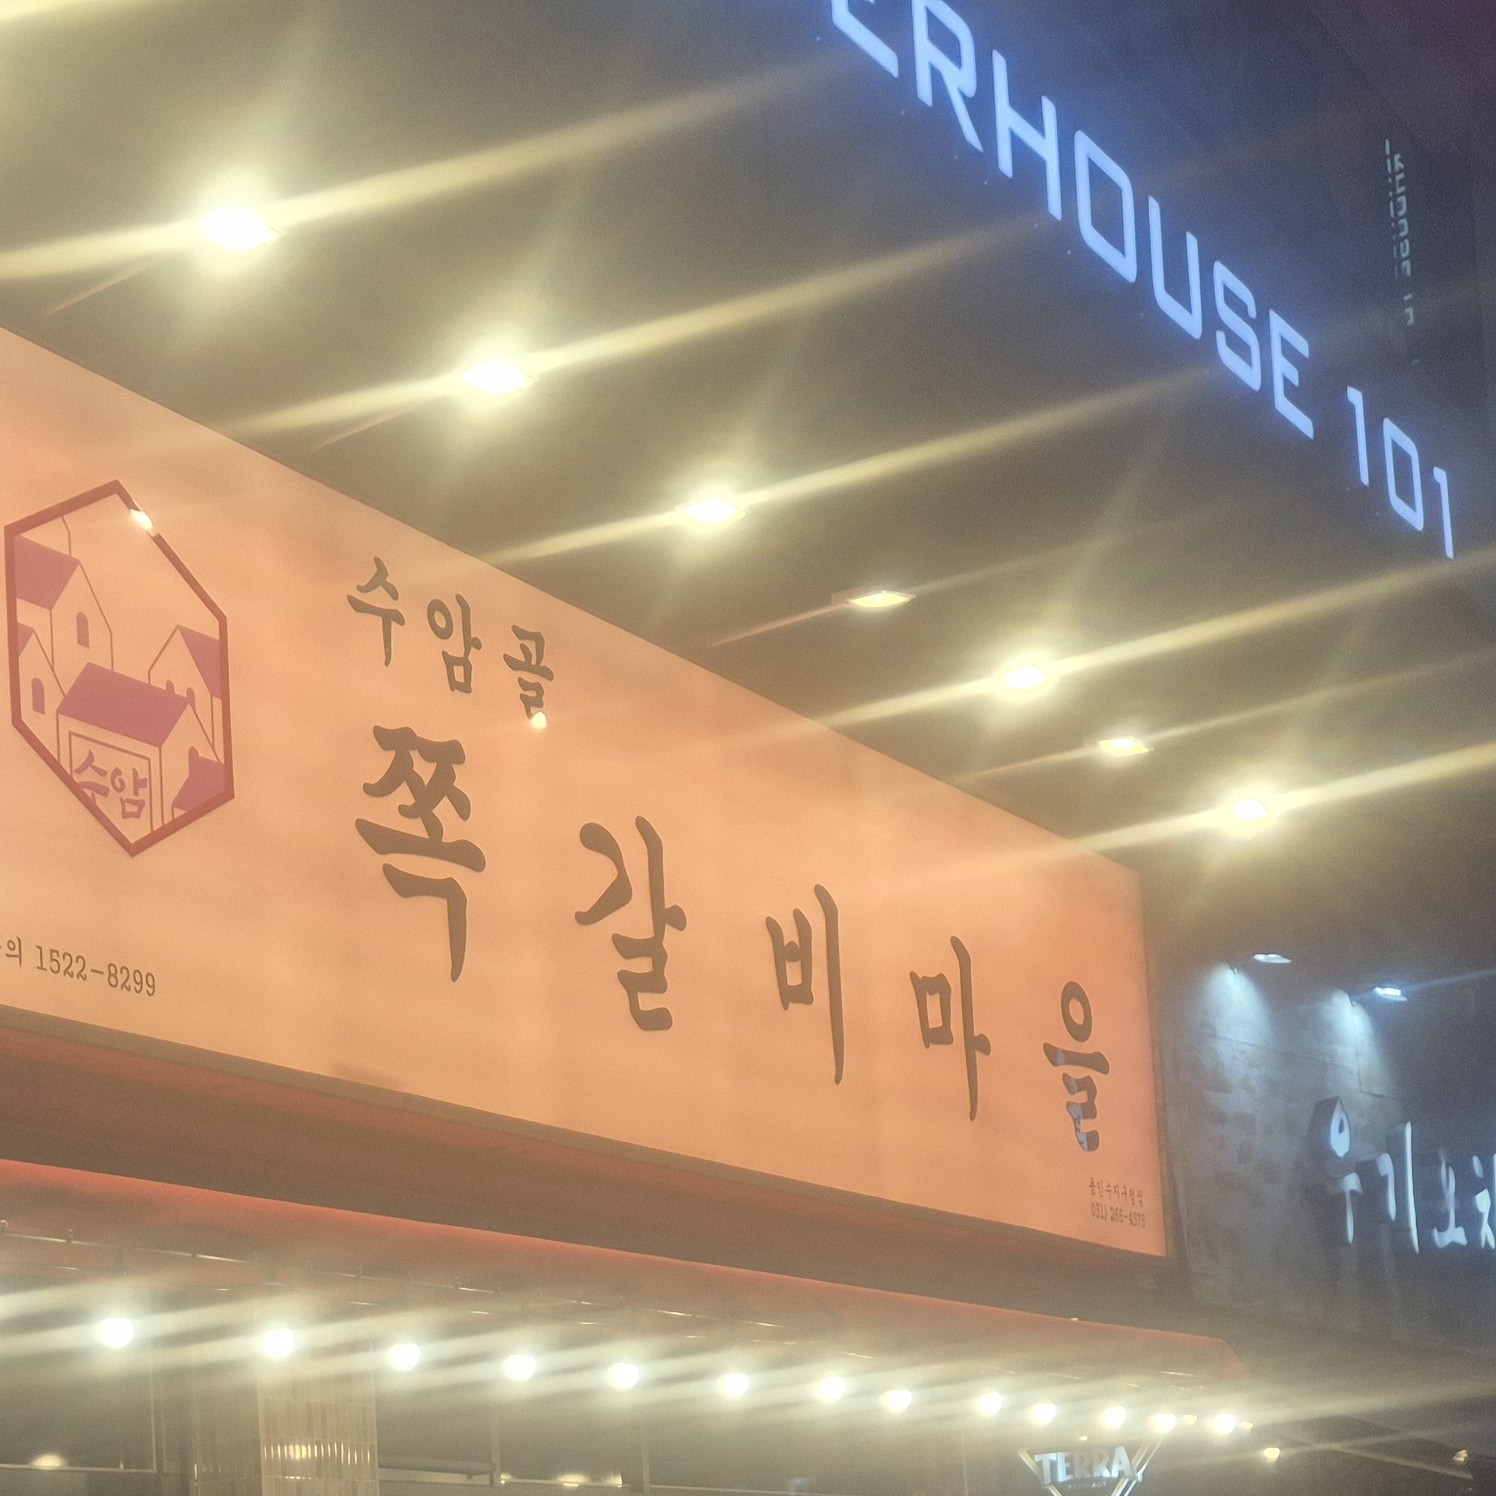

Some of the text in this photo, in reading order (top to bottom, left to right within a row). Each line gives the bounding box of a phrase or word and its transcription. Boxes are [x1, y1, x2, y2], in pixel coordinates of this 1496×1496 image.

[1346, 386, 1455, 560] 101
[347, 557, 554, 718] 수암골
[35, 945, 156, 997] 1522-8299
[1033, 1446, 1136, 1488] TERRA
